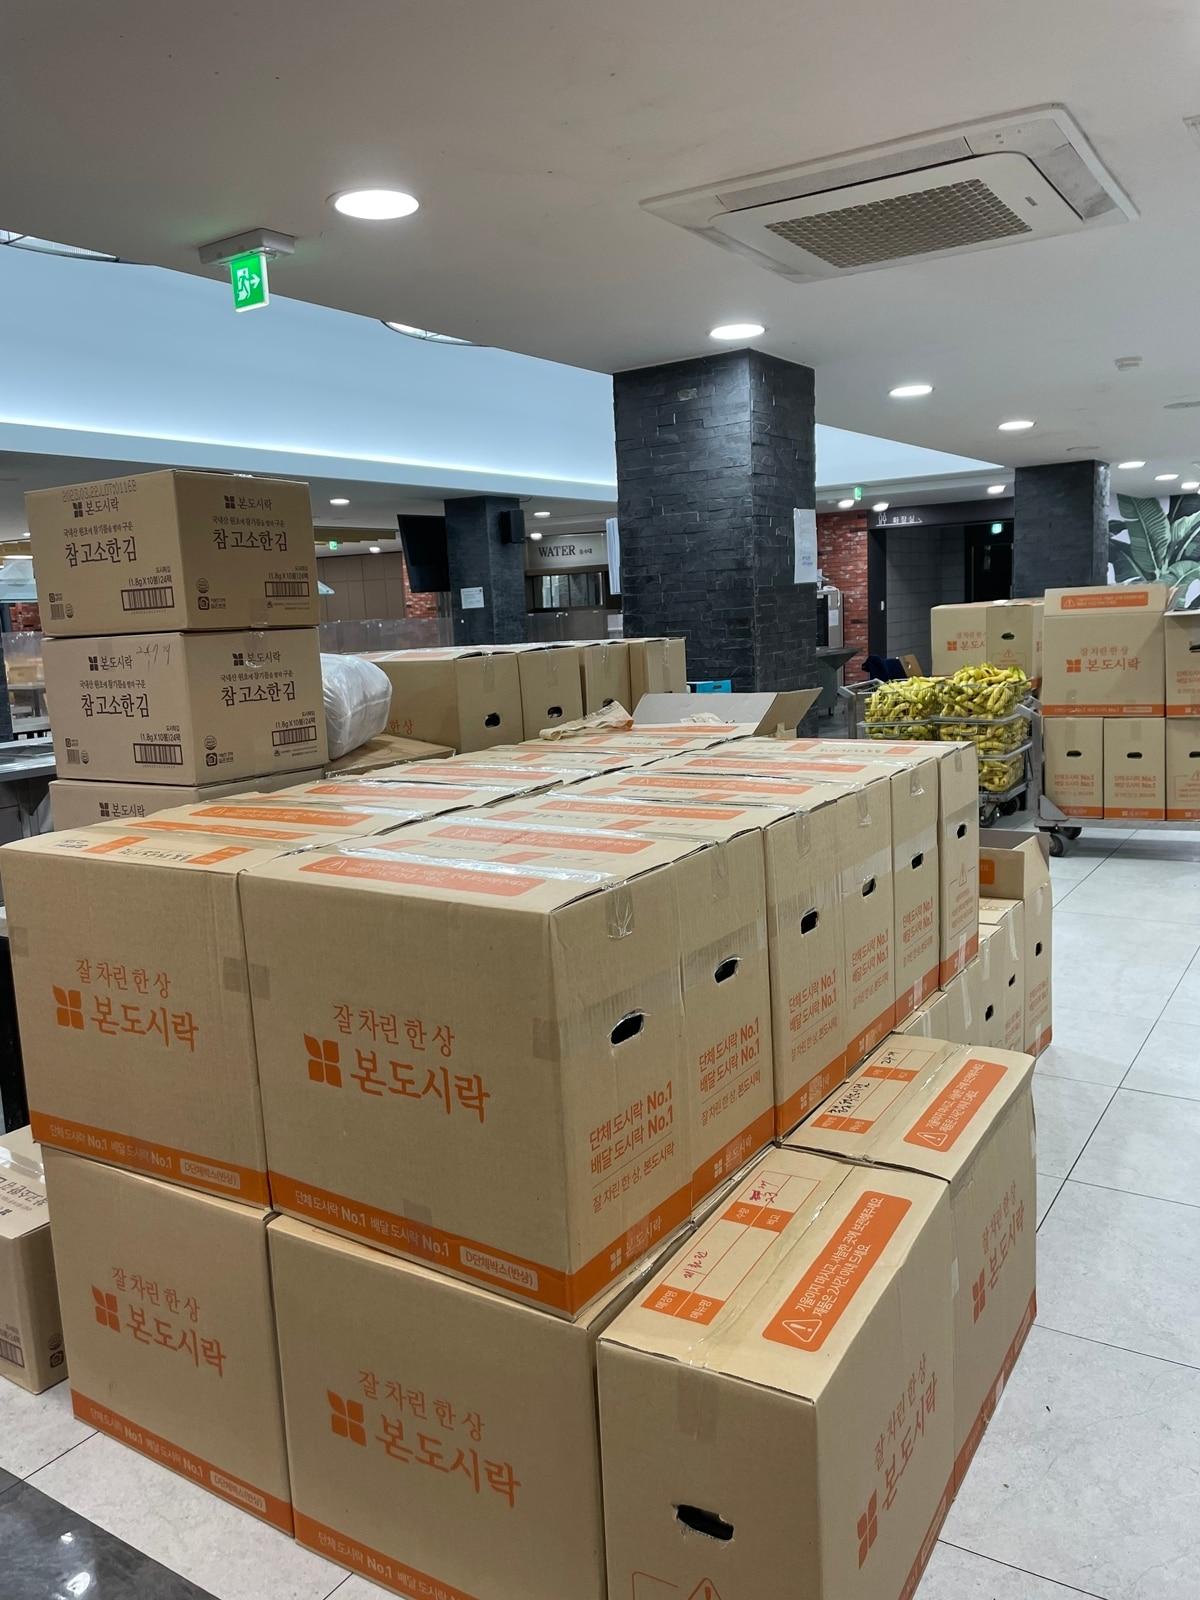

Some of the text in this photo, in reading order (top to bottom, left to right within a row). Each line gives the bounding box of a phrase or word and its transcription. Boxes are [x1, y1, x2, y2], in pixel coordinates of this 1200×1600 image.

[85, 497, 119, 515] 본도시락
[238, 497, 272, 511] 본도시락
[538, 545, 576, 557] WATER
[100, 655, 133, 671] 본도시락
[1087, 657, 1141, 672] 본도시락
[403, 719, 416, 736] 상
[111, 802, 146, 817] 본도시락
[877, 928, 888, 947] No.1
[877, 945, 888, 965] No.1
[76, 959, 171, 999] 잘 차린 한 상
[821, 968, 836, 992] No.1
[822, 987, 837, 1011] No.1
[91, 995, 199, 1052] 본도시락
[334, 1004, 455, 1057] 잘 차린 한 상
[740, 1016, 759, 1045] No.1
[741, 1038, 760, 1066] No.1
[350, 1048, 490, 1123] 본도시락
[613, 1100, 643, 1135] 도시락
[647, 1080, 672, 1114] No.1
[614, 1125, 644, 1160] 도시락
[648, 1105, 673, 1139] No.1
[87, 1135, 108, 1151] No.1
[151, 1152, 173, 1169] No.1
[643, 1141, 674, 1176] 본도시락
[341, 1206, 366, 1227] No.1
[422, 1234, 449, 1257] No.1
[988, 1200, 1024, 1289] 본도시락
[795, 1280, 824, 1312] 기울이지
[814, 1263, 839, 1286] 마시고,
[832, 1244, 853, 1268] 서늘한
[854, 1197, 884, 1232] 보관해주세요
[112, 1266, 200, 1323] 잘 차린 한 상
[812, 1244, 872, 1318] 제품은 2시간 이내 드세요
[655, 1290, 678, 1309] 매장명
[690, 1299, 712, 1319] 메뉴명
[126, 1303, 226, 1378] 본도시락
[359, 1370, 485, 1442] 잘 차린 한 상
[124, 1427, 143, 1444] No.1
[183, 1458, 204, 1478] No.1
[882, 1371, 937, 1511] 본도시락
[376, 1414, 521, 1508] 본도시락
[367, 1556, 392, 1578] No.1
